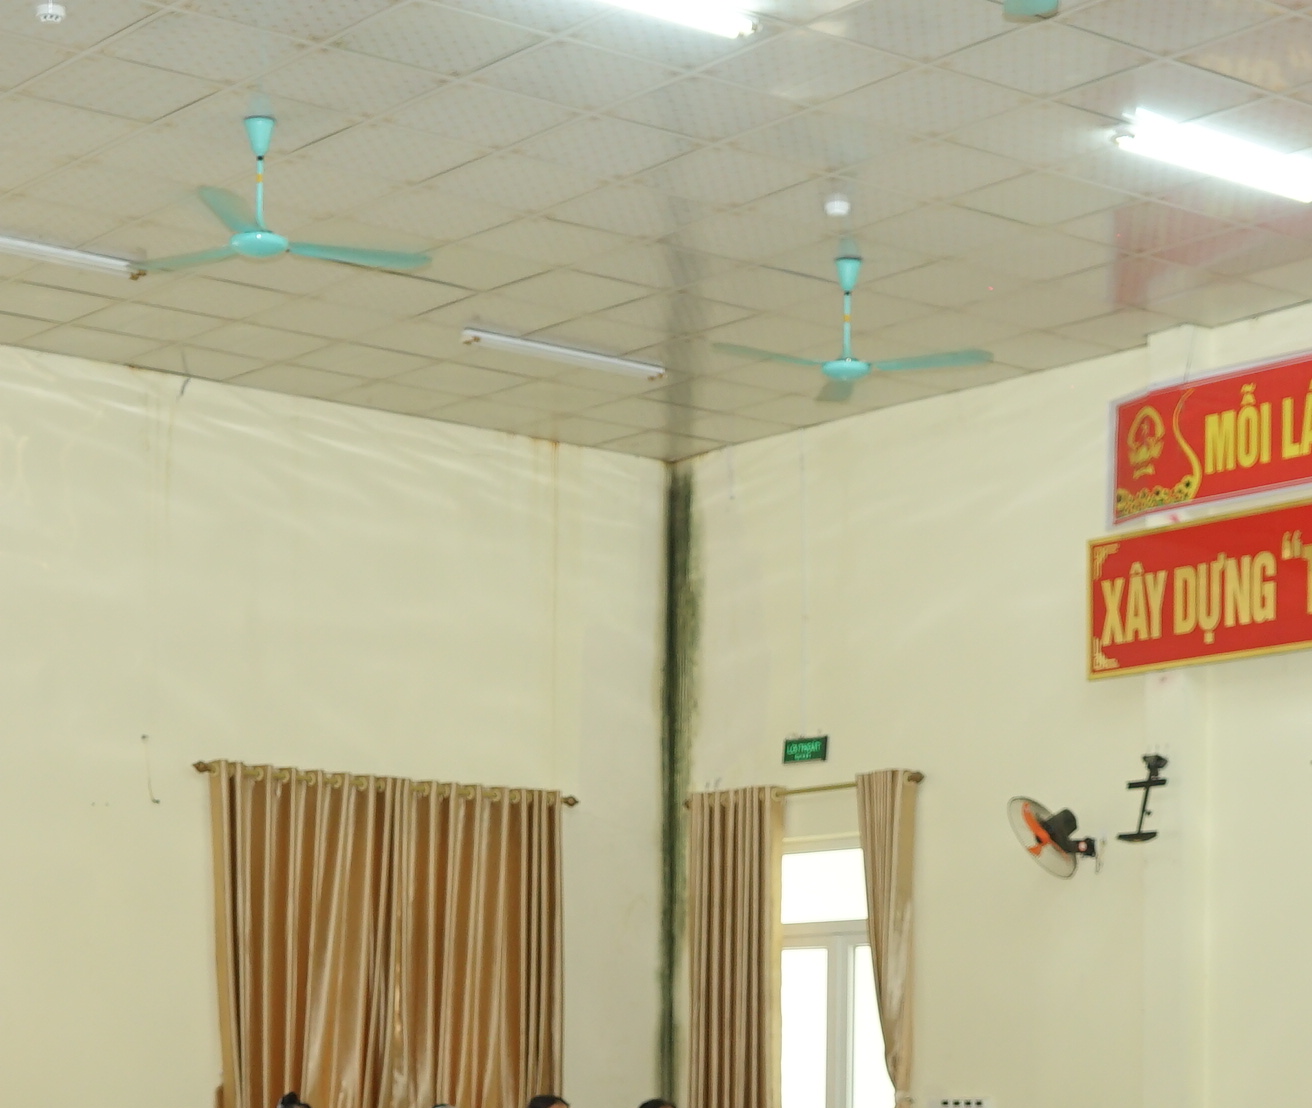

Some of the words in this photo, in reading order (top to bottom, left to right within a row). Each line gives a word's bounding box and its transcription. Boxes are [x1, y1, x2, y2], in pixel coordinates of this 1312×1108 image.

[1204, 382, 1272, 475] MỖI
[1100, 562, 1168, 646] XÂY
[1173, 550, 1277, 644] DỰNG
